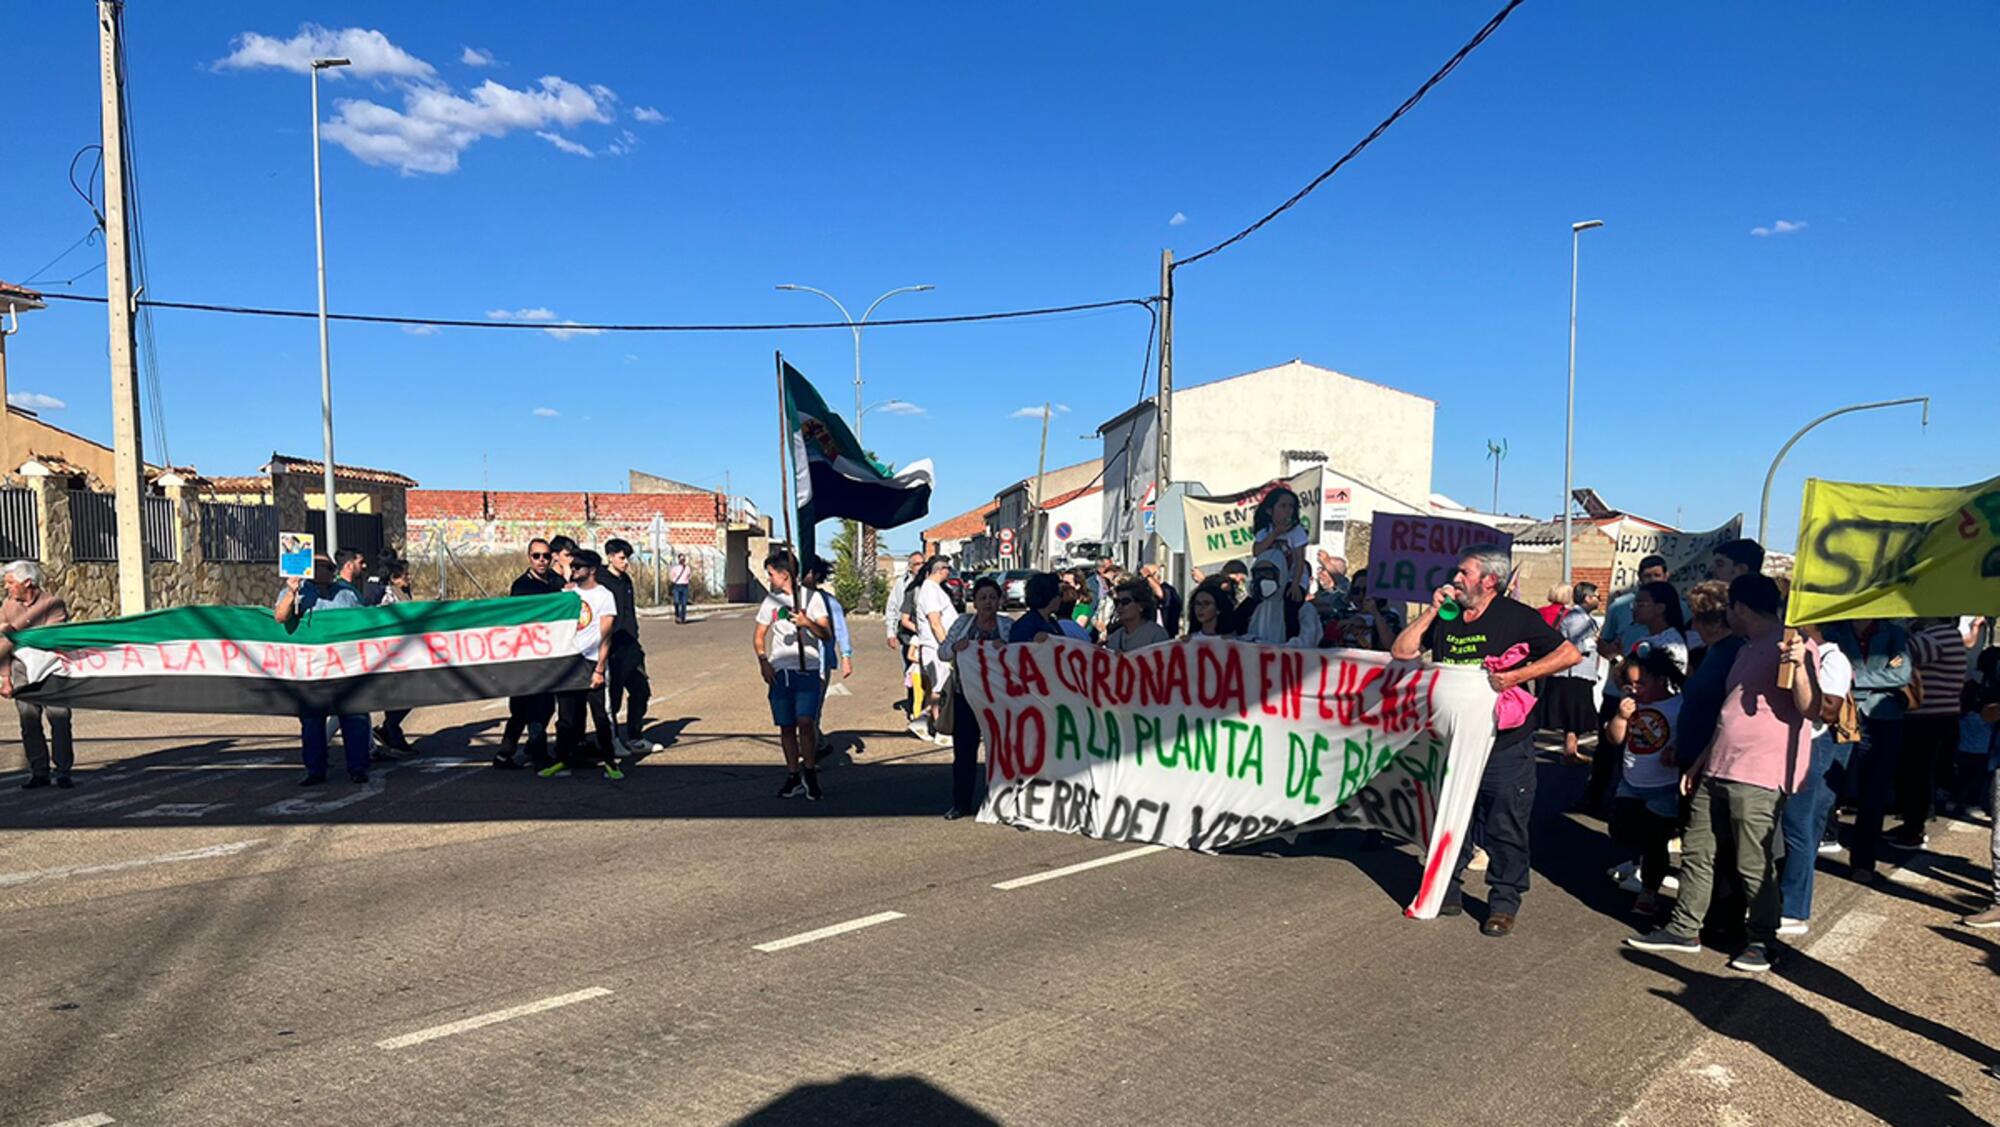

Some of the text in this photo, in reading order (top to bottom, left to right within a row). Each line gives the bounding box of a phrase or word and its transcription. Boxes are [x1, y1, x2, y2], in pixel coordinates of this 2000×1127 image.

[1206, 533, 1227, 551] NI
[1375, 560, 1416, 591] LA
[121, 643, 145, 671] A
[156, 641, 206, 671] LA
[220, 638, 347, 677] PLANTA
[358, 637, 408, 672] DE
[423, 622, 552, 666] BIOGAS
[1054, 644, 1248, 718] CORONADA
[1260, 651, 1303, 720] EN
[987, 705, 1047, 783] NO
[1055, 704, 1082, 761] A
[1086, 706, 1121, 762] LA
[1133, 712, 1264, 786] PLANTA
[1285, 731, 1330, 805] DE
